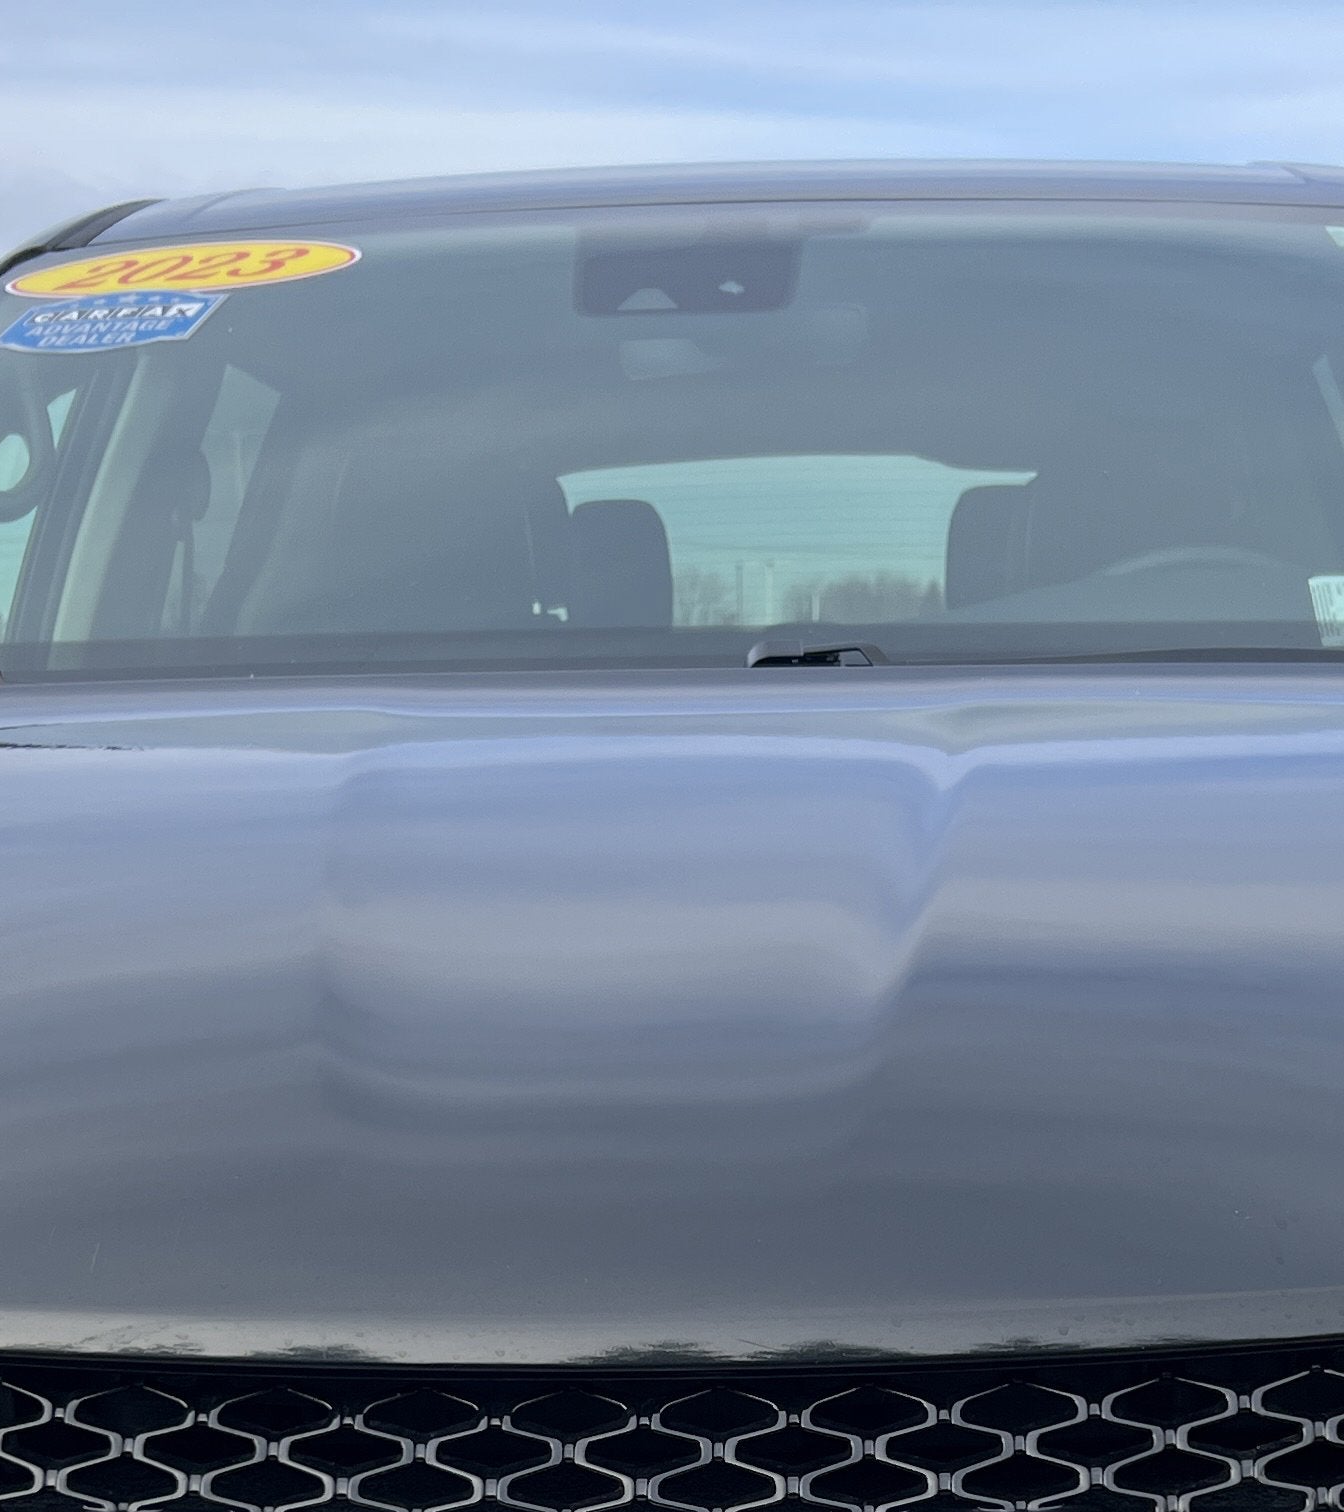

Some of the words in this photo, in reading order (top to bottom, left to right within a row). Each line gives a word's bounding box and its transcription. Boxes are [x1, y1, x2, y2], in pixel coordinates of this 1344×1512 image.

[50, 247, 310, 292] 2023
[33, 302, 201, 323] CARFAX
[25, 318, 174, 337] ADVANTAGE
[36, 332, 137, 348] DEALER
